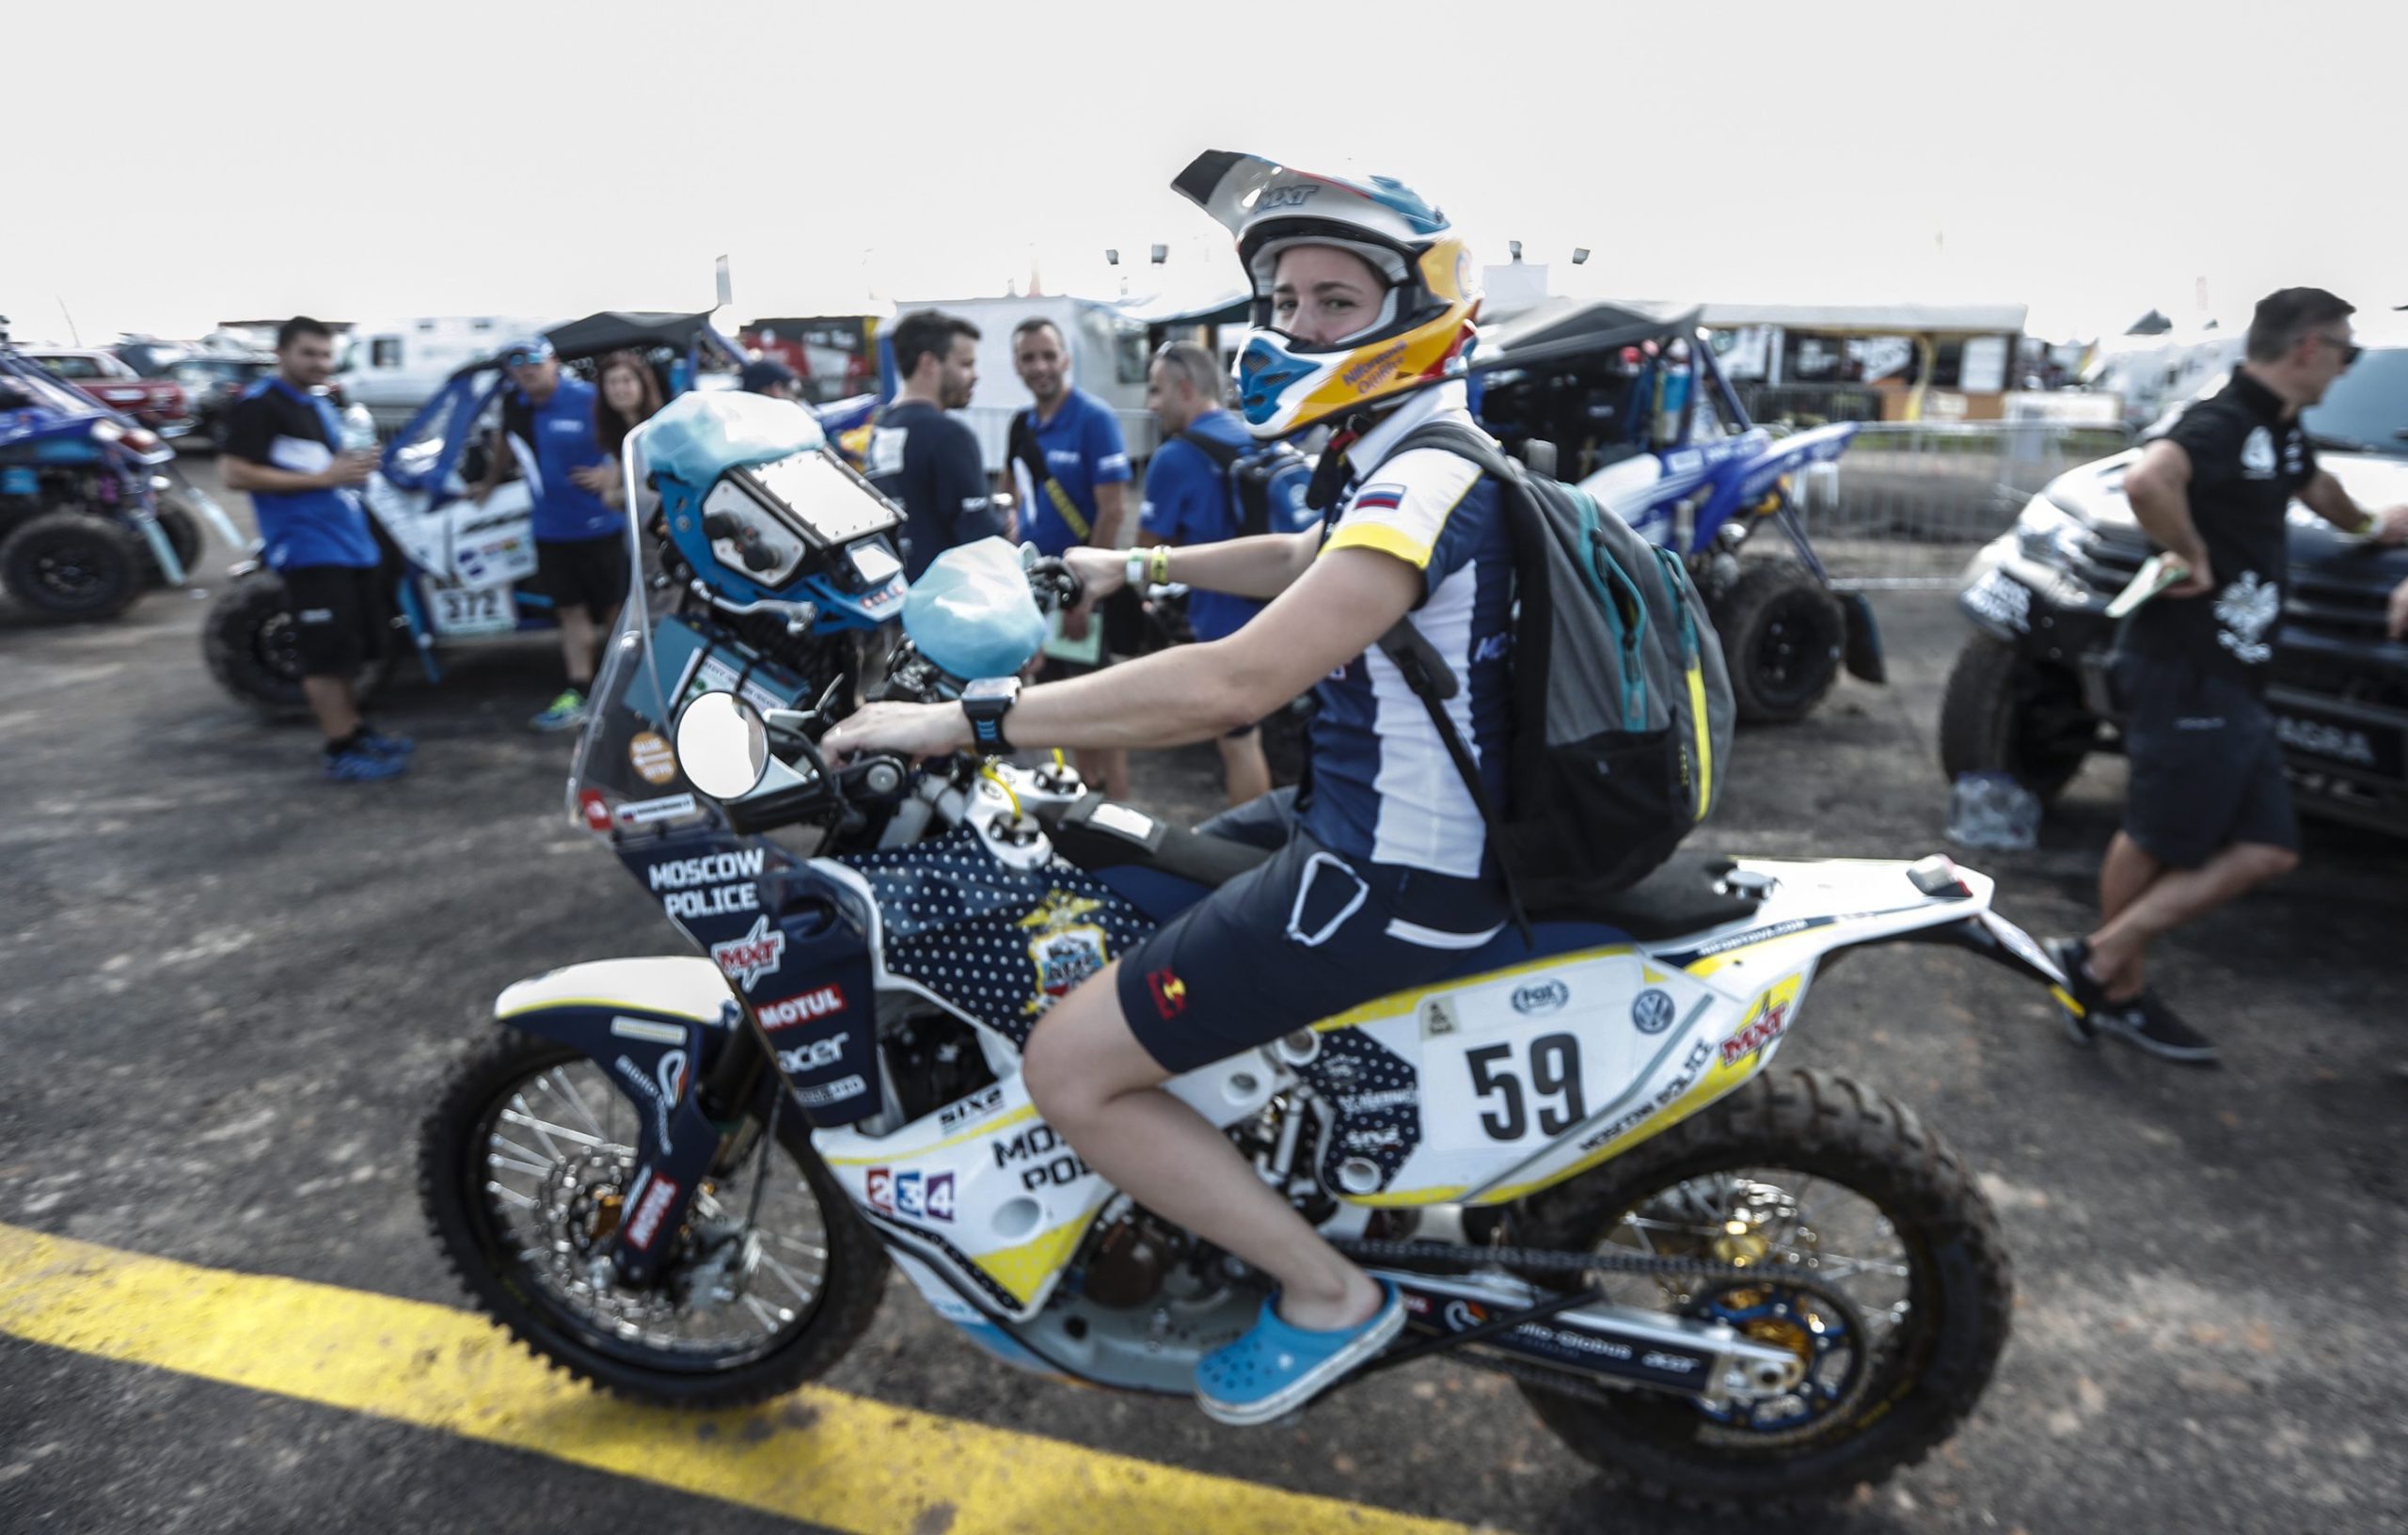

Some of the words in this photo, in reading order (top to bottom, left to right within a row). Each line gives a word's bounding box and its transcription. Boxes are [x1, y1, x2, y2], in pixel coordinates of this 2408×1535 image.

[649, 847, 764, 891] MOSCOW
[664, 882, 759, 919] POLICE
[717, 936, 781, 973] MXT
[758, 988, 843, 1029] MOTUL
[777, 1032, 850, 1073] acer
[1719, 1001, 1789, 1068] MXT
[1465, 1033, 1588, 1141] 59
